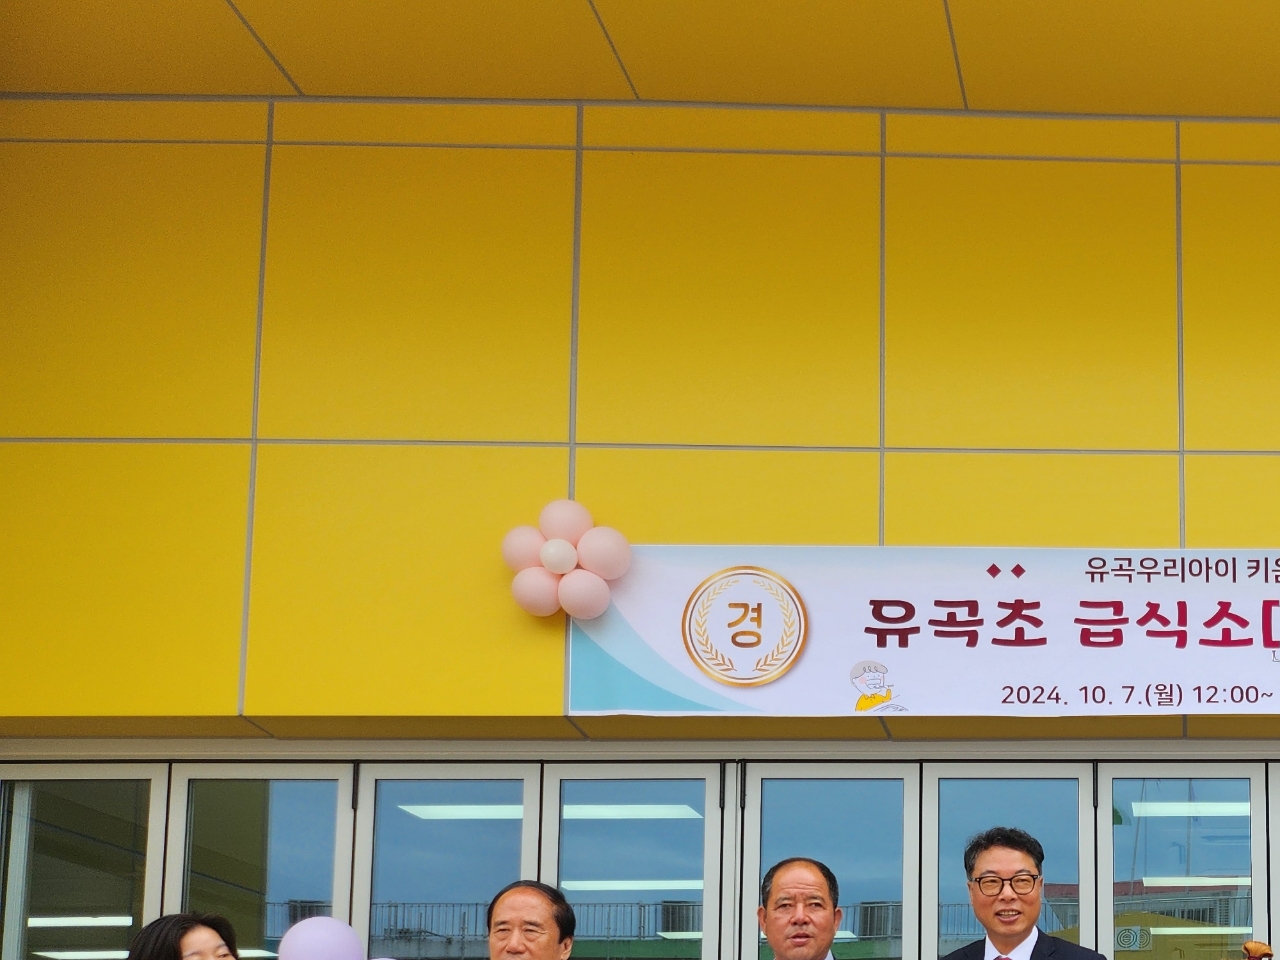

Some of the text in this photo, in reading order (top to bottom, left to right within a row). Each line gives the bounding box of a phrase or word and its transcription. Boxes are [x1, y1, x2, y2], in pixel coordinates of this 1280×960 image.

[1085, 557, 1237, 585] 유곡우리아이
[727, 602, 763, 649] 경
[863, 599, 1048, 649] 유곡초
[1001, 684, 1274, 708] 2024. 10. 7.(월) 12:00~
